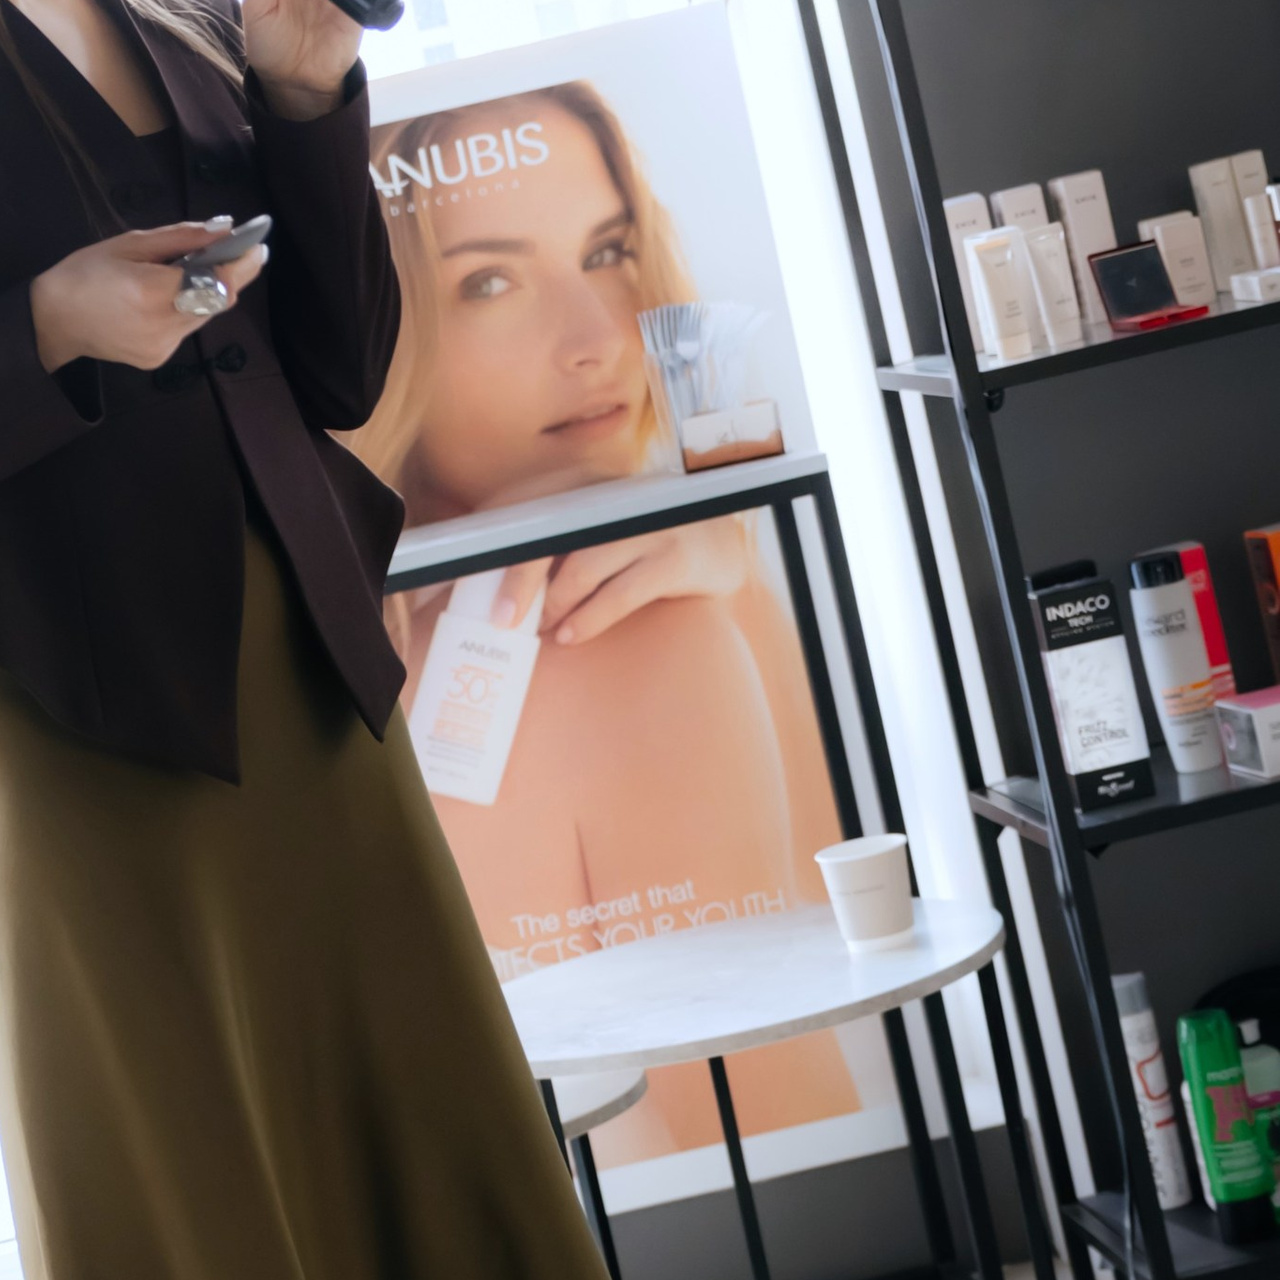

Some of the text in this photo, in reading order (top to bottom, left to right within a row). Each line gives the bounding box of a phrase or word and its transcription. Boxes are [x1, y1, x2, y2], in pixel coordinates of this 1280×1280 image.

[389, 177, 520, 217] barcelona
[1045, 594, 1110, 622] INDACO
[511, 879, 696, 939] The secret that
[683, 887, 788, 928] YOUTH
